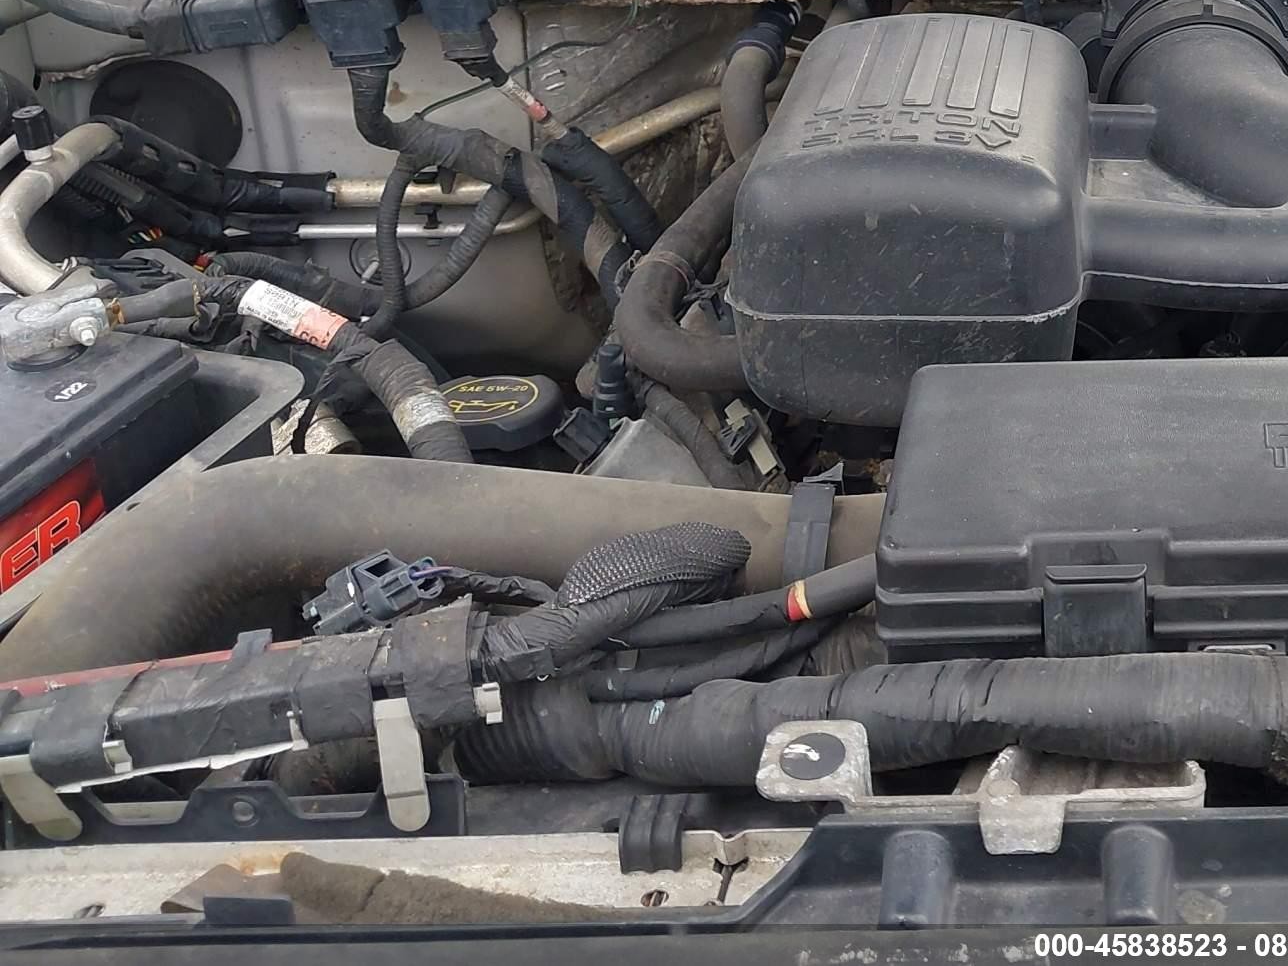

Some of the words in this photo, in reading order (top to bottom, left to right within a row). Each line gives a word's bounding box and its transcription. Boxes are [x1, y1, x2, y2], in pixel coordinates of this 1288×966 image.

[804, 110, 1022, 138] TRITON
[934, 130, 1013, 151] 3V
[458, 385, 484, 393] SAE
[486, 385, 529, 393] 5W-20
